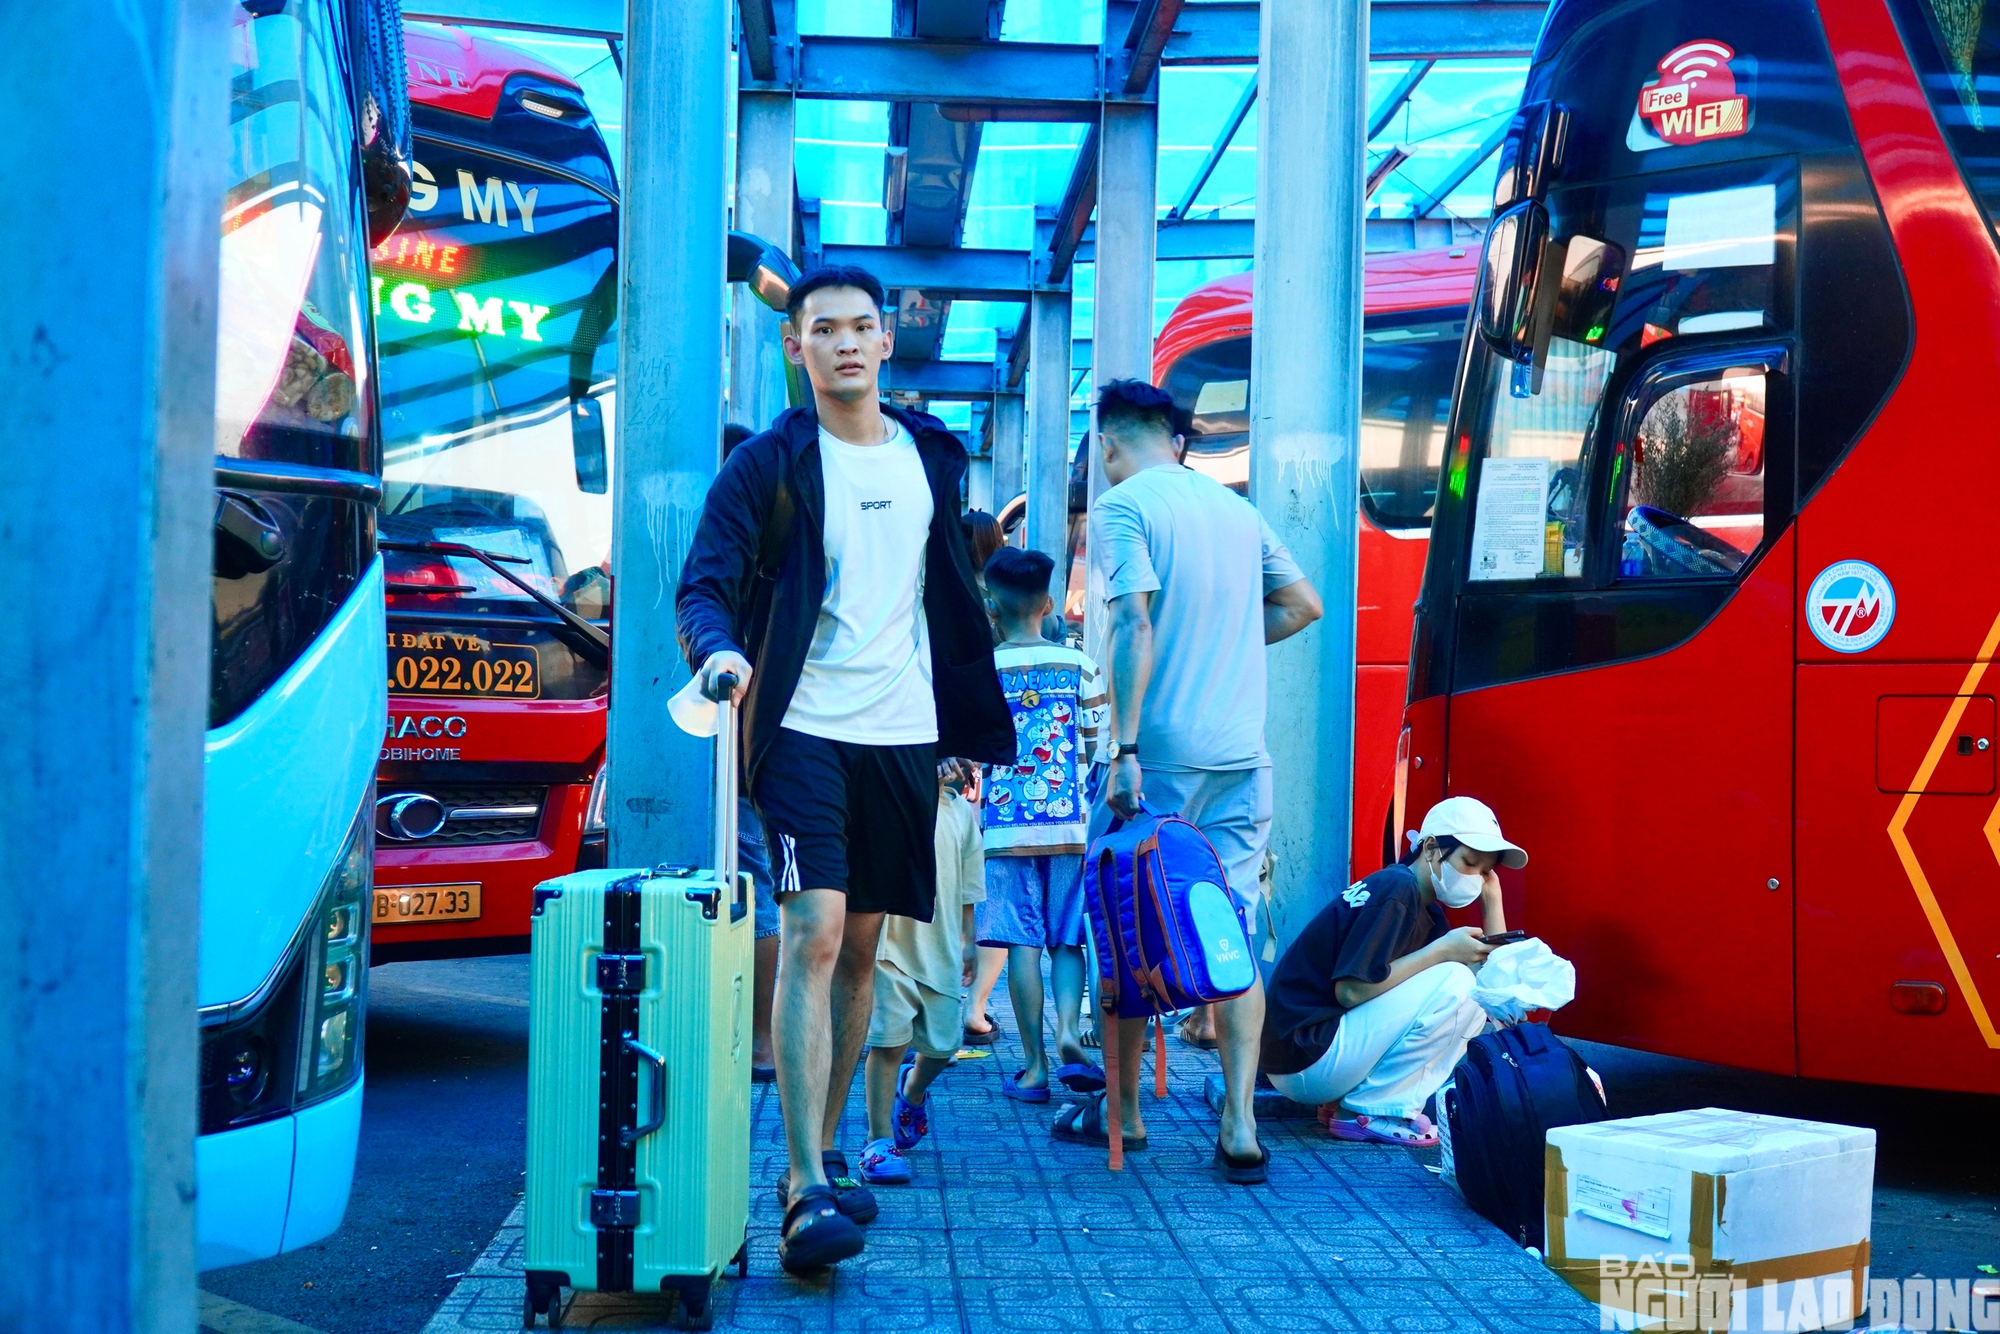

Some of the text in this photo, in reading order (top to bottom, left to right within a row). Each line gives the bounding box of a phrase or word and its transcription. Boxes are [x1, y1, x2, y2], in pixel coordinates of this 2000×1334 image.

[1648, 91, 1683, 108] Free
[456, 168, 540, 234] MY
[456, 292, 550, 342] MY
[860, 500, 892, 511] SPORT
[401, 631, 446, 652] ĐẶT
[998, 667, 1081, 693] RAEMON
[1215, 950, 1241, 963] VNVC
